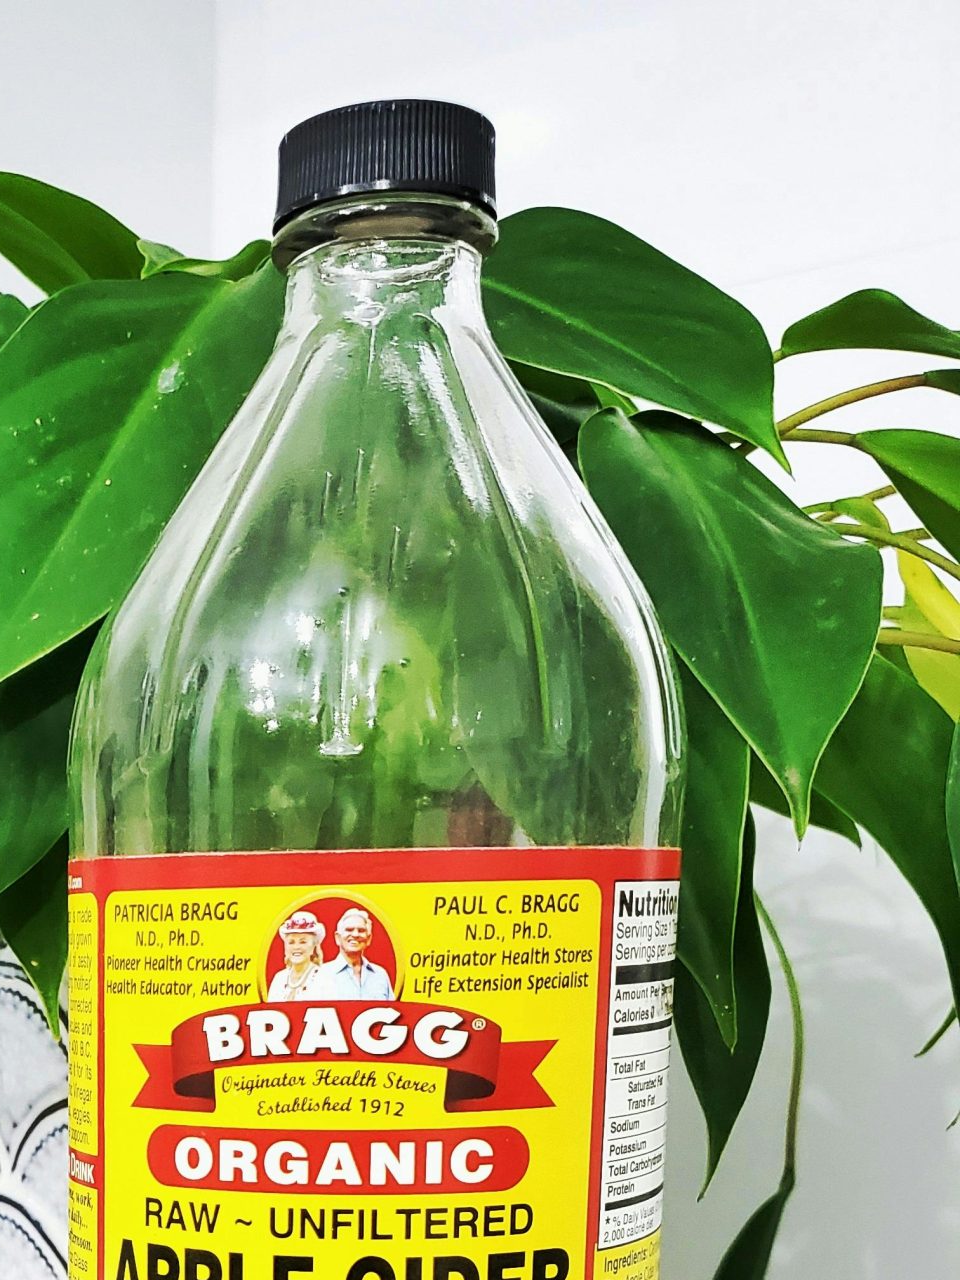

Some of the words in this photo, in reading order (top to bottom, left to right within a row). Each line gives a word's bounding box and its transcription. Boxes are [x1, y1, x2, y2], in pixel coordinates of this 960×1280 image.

[114, 903, 174, 923] PATRICIA
[180, 902, 238, 921] BRAGG
[434, 895, 488, 916] PAUL
[496, 895, 513, 914] C.
[521, 893, 580, 913] BRAGG
[136, 930, 164, 949] N.D.,
[168, 928, 204, 947] Ph.D.
[465, 923, 505, 943] N.D.,
[512, 921, 552, 940] Ph.D.
[616, 921, 653, 941] Serving
[654, 919, 668, 938] Size
[106, 954, 141, 971] Pioneer
[144, 954, 182, 971] Health
[187, 953, 251, 971] Crusader
[410, 950, 496, 972] Originator
[501, 947, 550, 966] Health
[554, 948, 593, 964] Stores
[615, 942, 656, 963] Servings
[106, 978, 137, 995] Health
[140, 979, 196, 998] Educator,
[201, 979, 251, 996] Author
[414, 976, 443, 998] Life
[448, 974, 522, 994] Extension
[527, 971, 589, 995] Specialist
[614, 986, 649, 1002] Amount
[650, 984, 660, 998] Per
[614, 1006, 650, 1024] Calories
[613, 1061, 633, 1075] Total
[634, 1059, 646, 1072] Fat
[222, 1071, 305, 1096] Originator
[312, 1069, 377, 1088] Health
[383, 1071, 437, 1094] Stores
[627, 1076, 656, 1094] Saturated
[257, 1097, 352, 1117] Established
[359, 1098, 406, 1118] 1912
[627, 1096, 646, 1112] Trans
[647, 1093, 656, 1107] Fat
[609, 1120, 640, 1135] Sodium
[608, 1140, 648, 1157] Potassium
[70, 1152, 95, 1185] DRINK
[173, 1135, 495, 1187] ORGANIC
[608, 1163, 628, 1178] Total
[607, 1182, 635, 1198] Protein
[145, 1197, 220, 1233] RAW
[269, 1203, 534, 1240] UNFILTERED
[622, 1207, 639, 1226] Daily
[602, 1227, 626, 1244] 2,000
